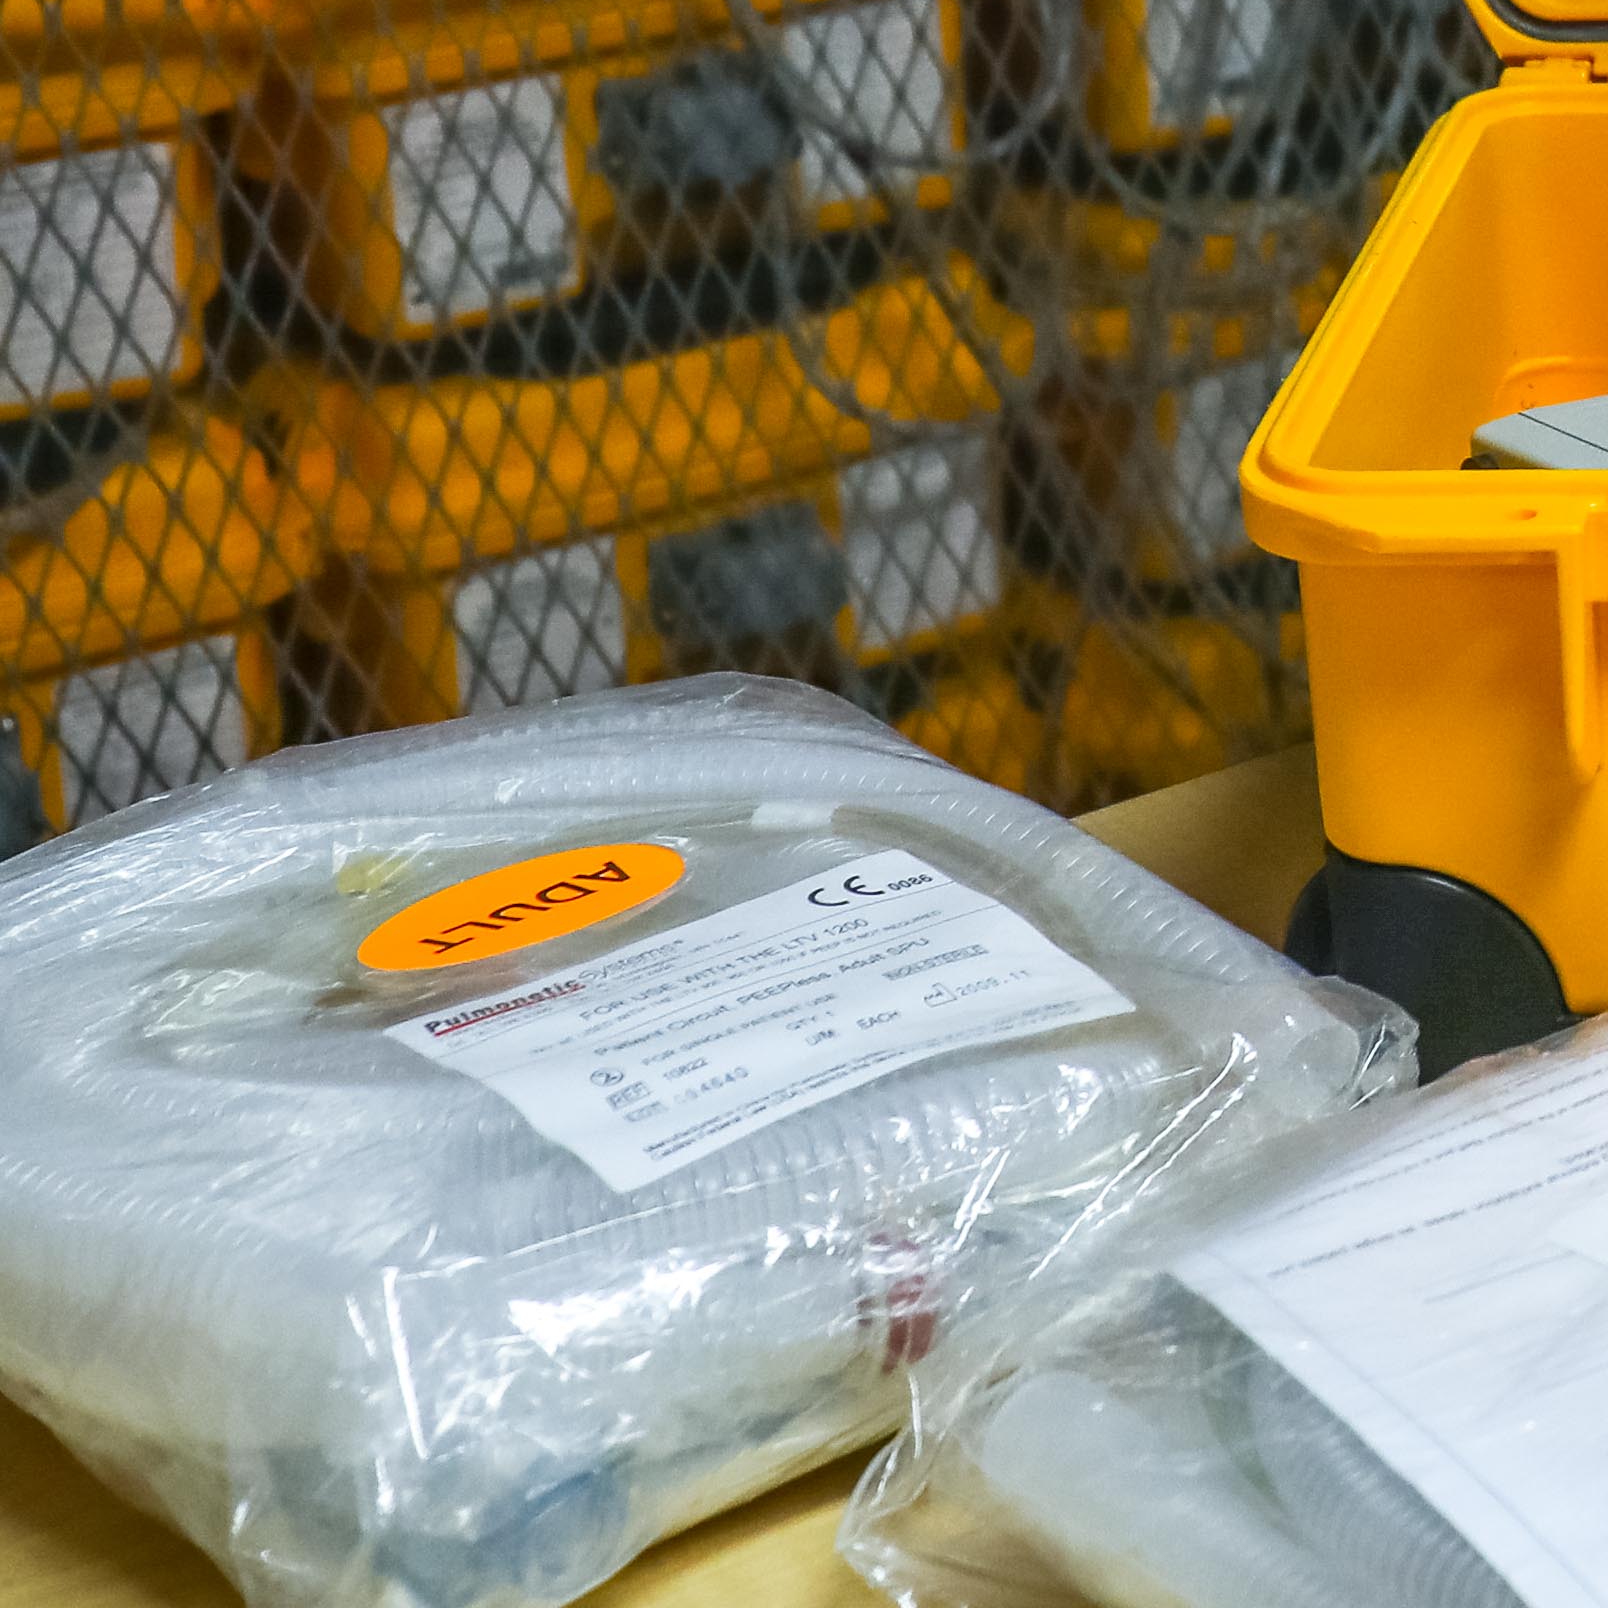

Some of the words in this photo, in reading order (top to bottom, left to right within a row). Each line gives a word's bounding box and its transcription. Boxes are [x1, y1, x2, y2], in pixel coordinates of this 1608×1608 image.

[887, 873, 934, 893] 0086
[417, 860, 631, 954] ADULT
[578, 998, 625, 1023] FOR
[639, 982, 674, 1005] USE
[681, 961, 734, 984] WITH
[735, 946, 782, 969] THE
[788, 932, 818, 953] LTV
[823, 916, 870, 938] 1200
[839, 951, 885, 974] Adult
[857, 1009, 902, 1032] EACH
